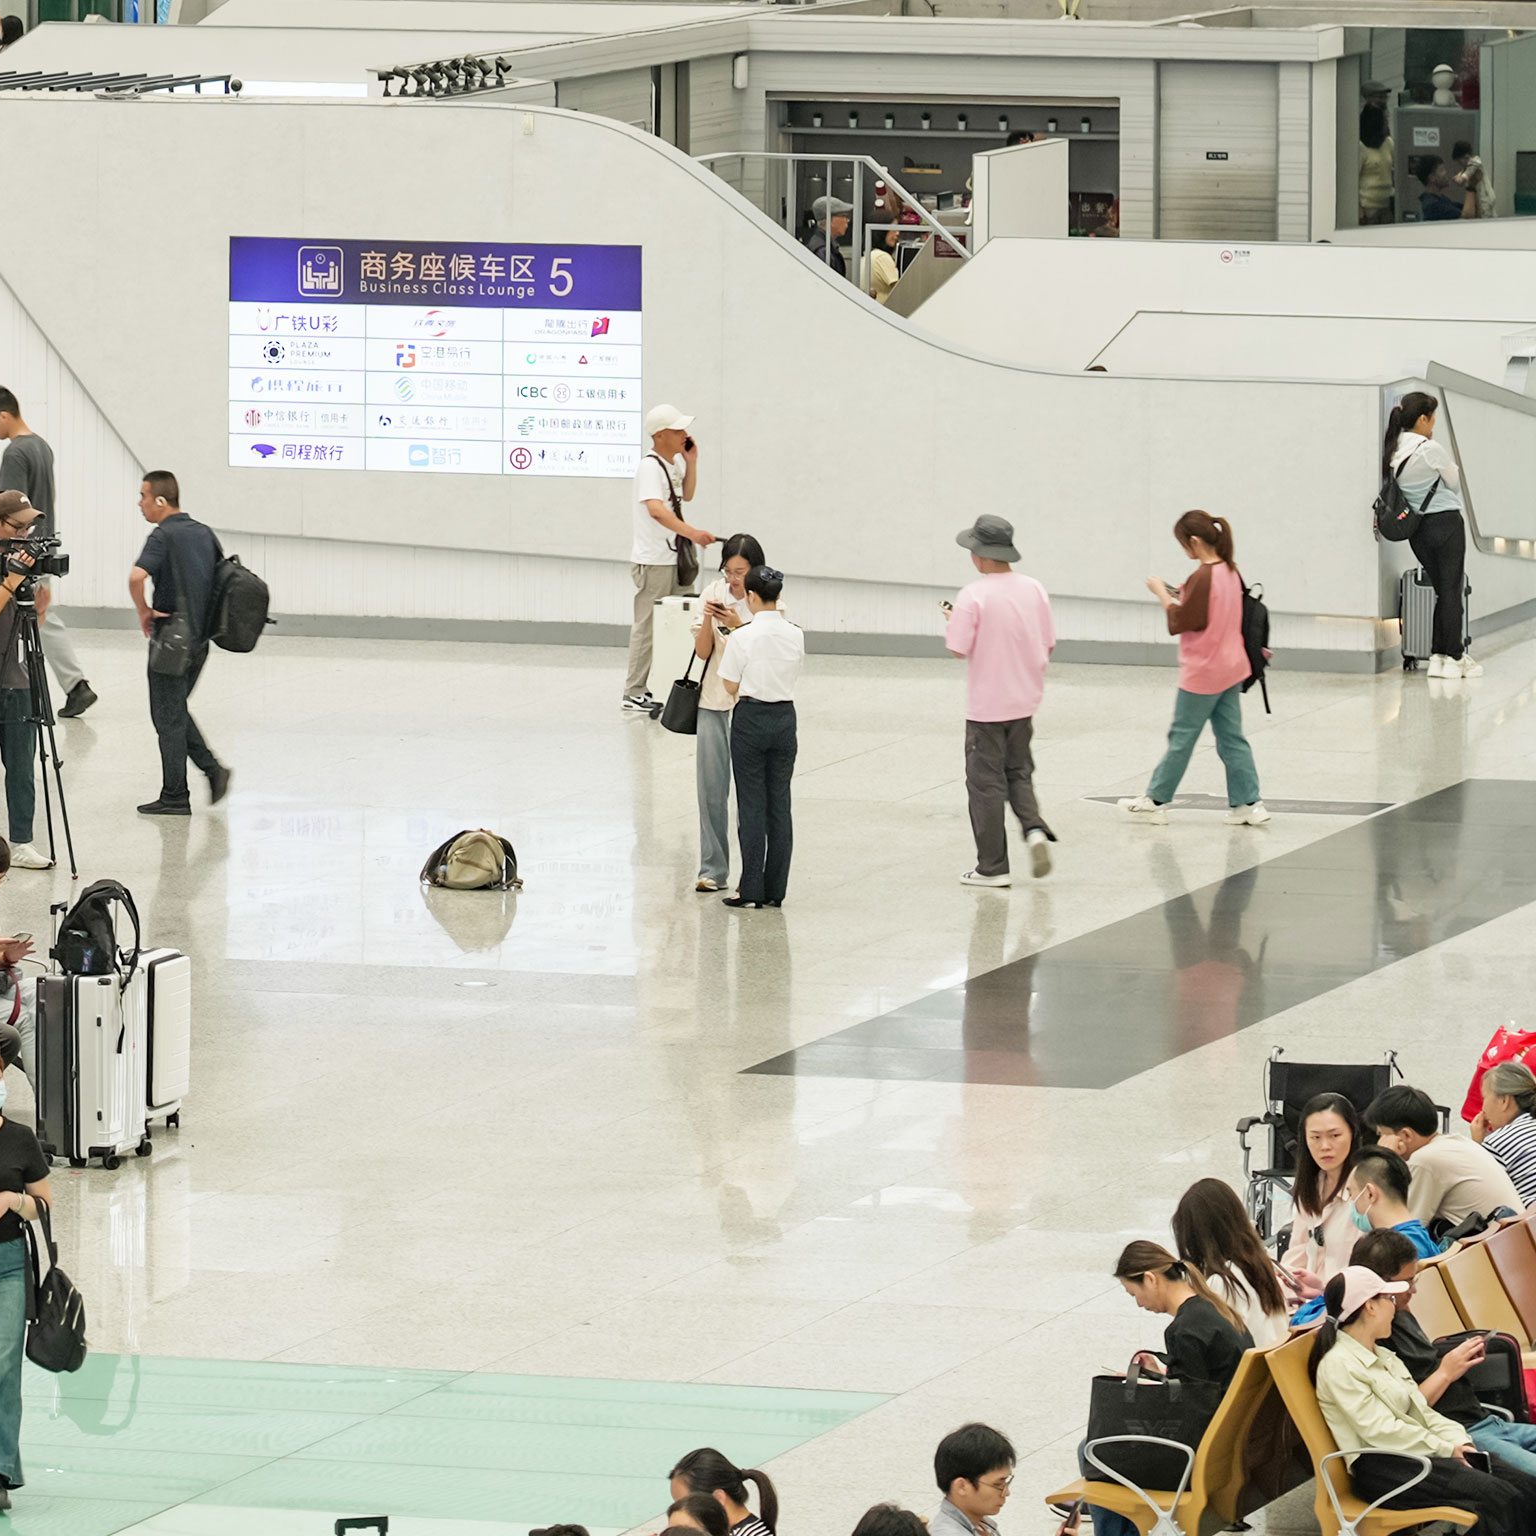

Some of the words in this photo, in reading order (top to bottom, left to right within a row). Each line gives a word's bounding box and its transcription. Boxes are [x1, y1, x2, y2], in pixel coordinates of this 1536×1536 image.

[359, 250, 535, 284] 商务座候车区
[548, 258, 574, 296] 5
[359, 280, 429, 296] Business
[432, 281, 476, 296] Class
[479, 282, 535, 299] Lounge
[275, 315, 339, 332] 广铁U彩
[290, 341, 319, 349] PLAZA
[290, 350, 332, 358] PREMIUM
[421, 346, 471, 360] 空港易行
[516, 386, 548, 398] ICBC
[576, 389, 627, 400] 工银信用卡
[263, 409, 310, 422] 中信银行
[281, 443, 344, 461] 同程旅行
[432, 448, 462, 465] 智行
